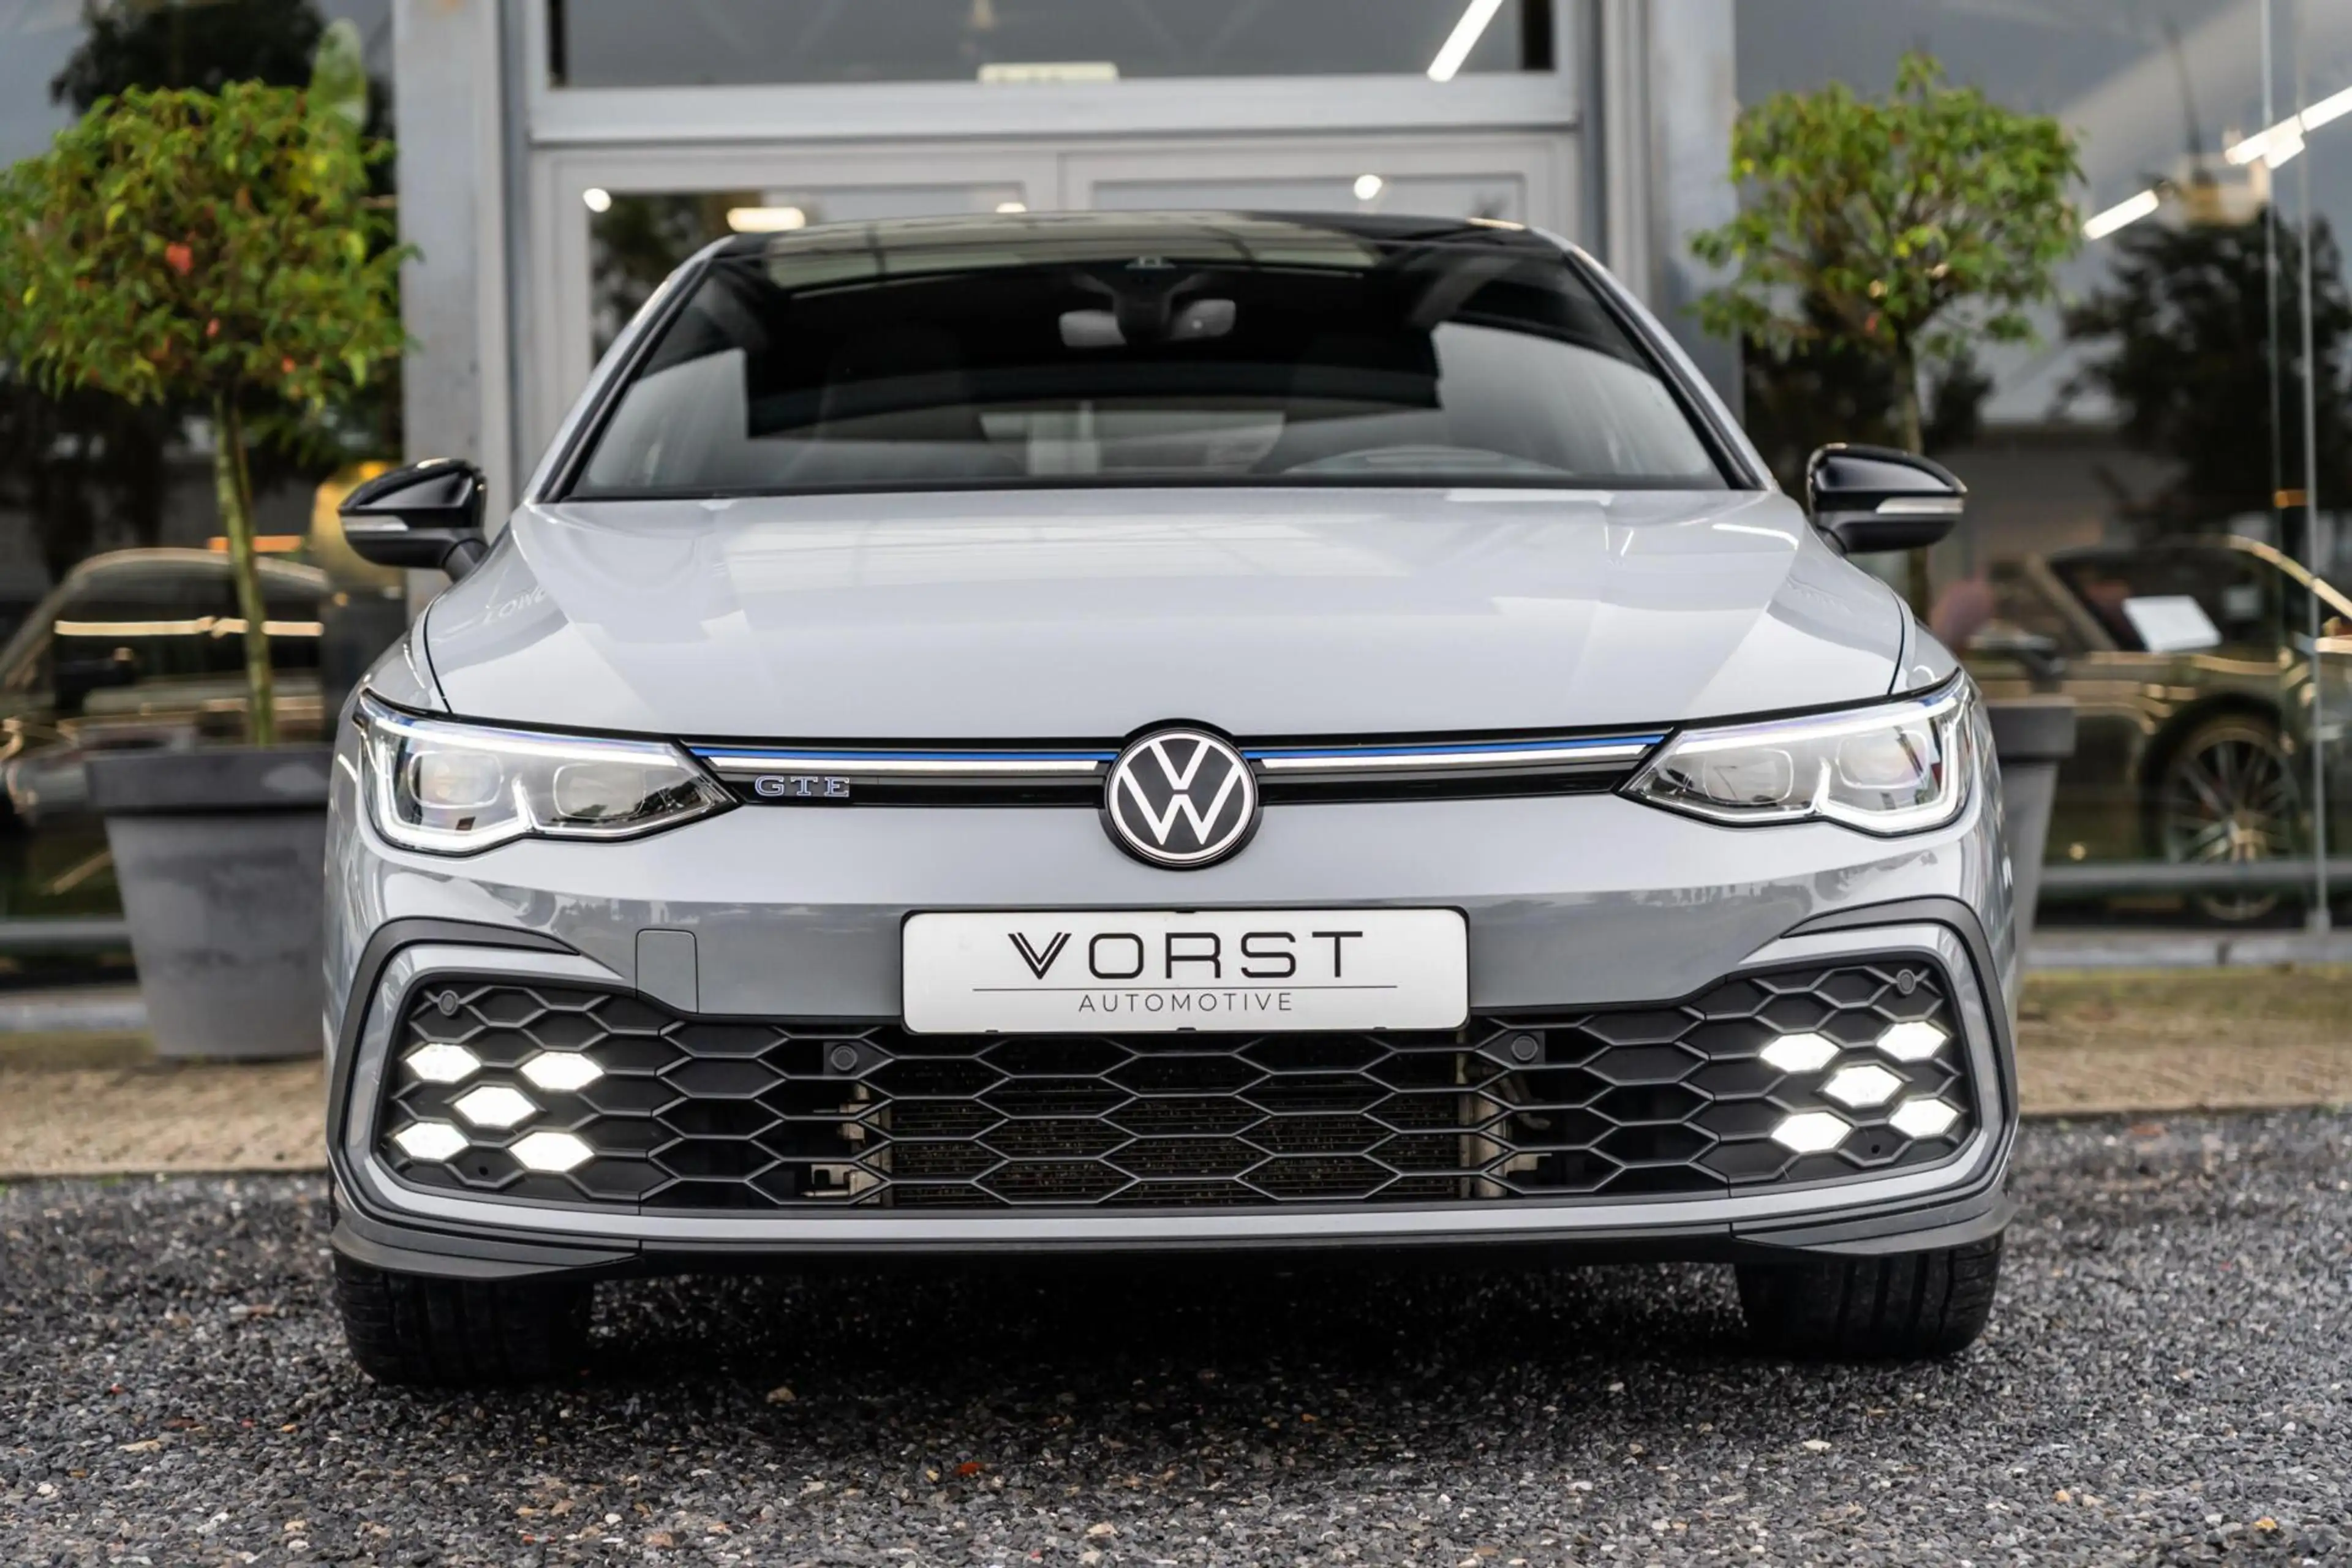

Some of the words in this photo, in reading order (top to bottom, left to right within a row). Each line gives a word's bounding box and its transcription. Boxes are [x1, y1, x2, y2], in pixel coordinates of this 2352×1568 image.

[754, 775, 850, 797] GTE
[1118, 736, 1242, 846] VW
[1008, 930, 1363, 980] VORST
[1078, 992, 1293, 1012] AUTOMOTIVE
